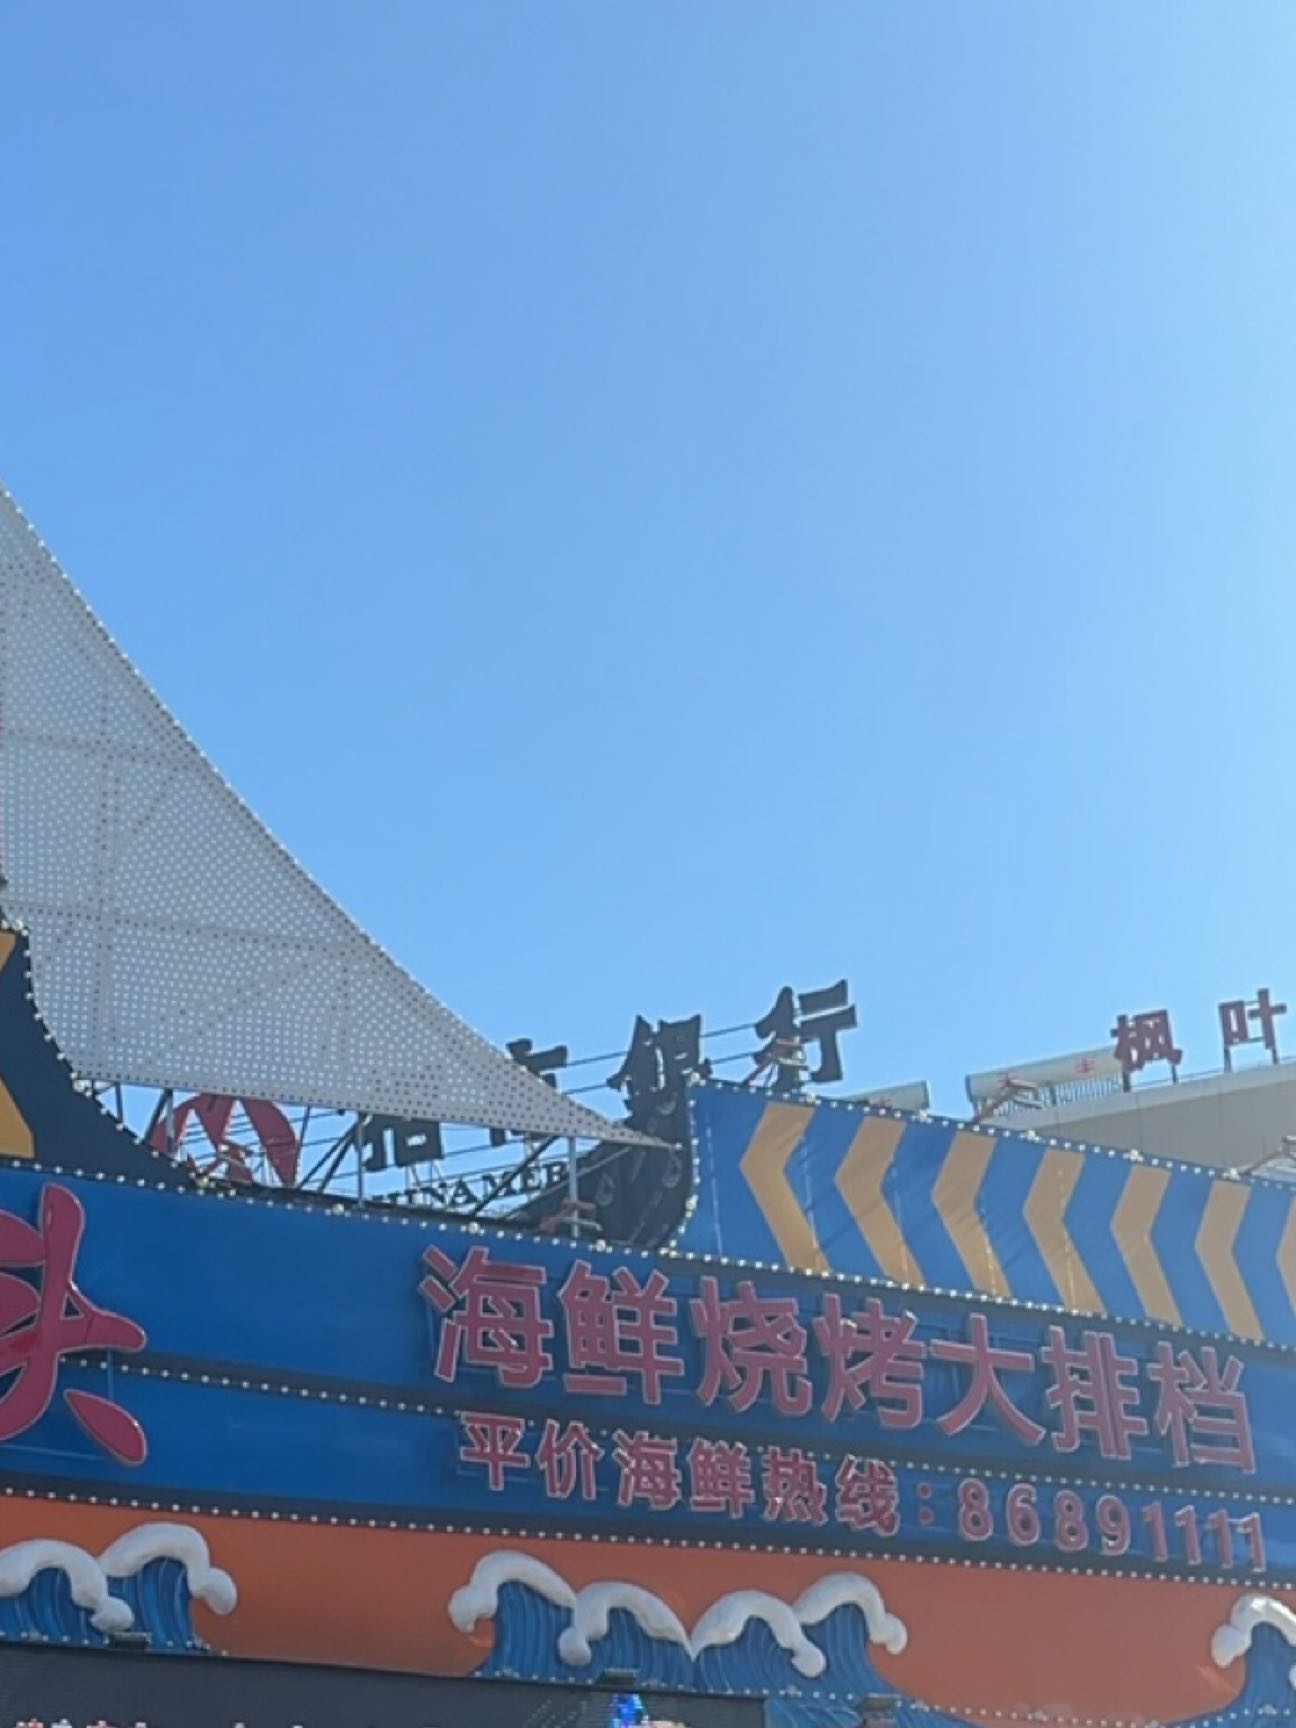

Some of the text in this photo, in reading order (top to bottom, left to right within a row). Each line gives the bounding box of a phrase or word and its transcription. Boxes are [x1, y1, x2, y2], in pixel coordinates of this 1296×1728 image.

[1109, 987, 1288, 1076] 枫叶
[420, 1243, 1257, 1475] 海鲜烧烤大排档
